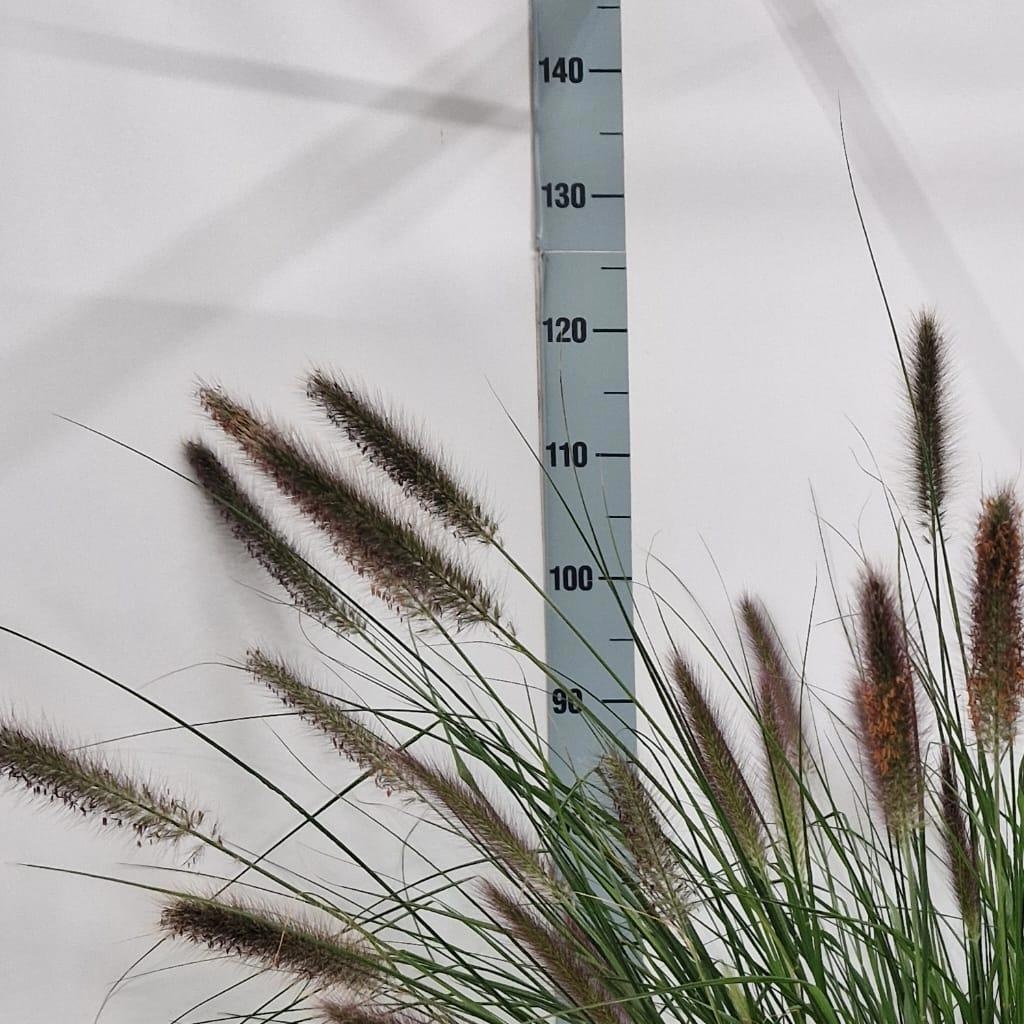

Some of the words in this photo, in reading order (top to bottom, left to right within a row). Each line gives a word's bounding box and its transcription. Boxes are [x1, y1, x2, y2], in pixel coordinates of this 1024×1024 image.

[538, 57, 584, 83] 140
[541, 182, 586, 209] 130
[542, 317, 587, 343] 120
[546, 441, 588, 468] 110
[550, 565, 593, 591] 100
[552, 688, 583, 714] 90
